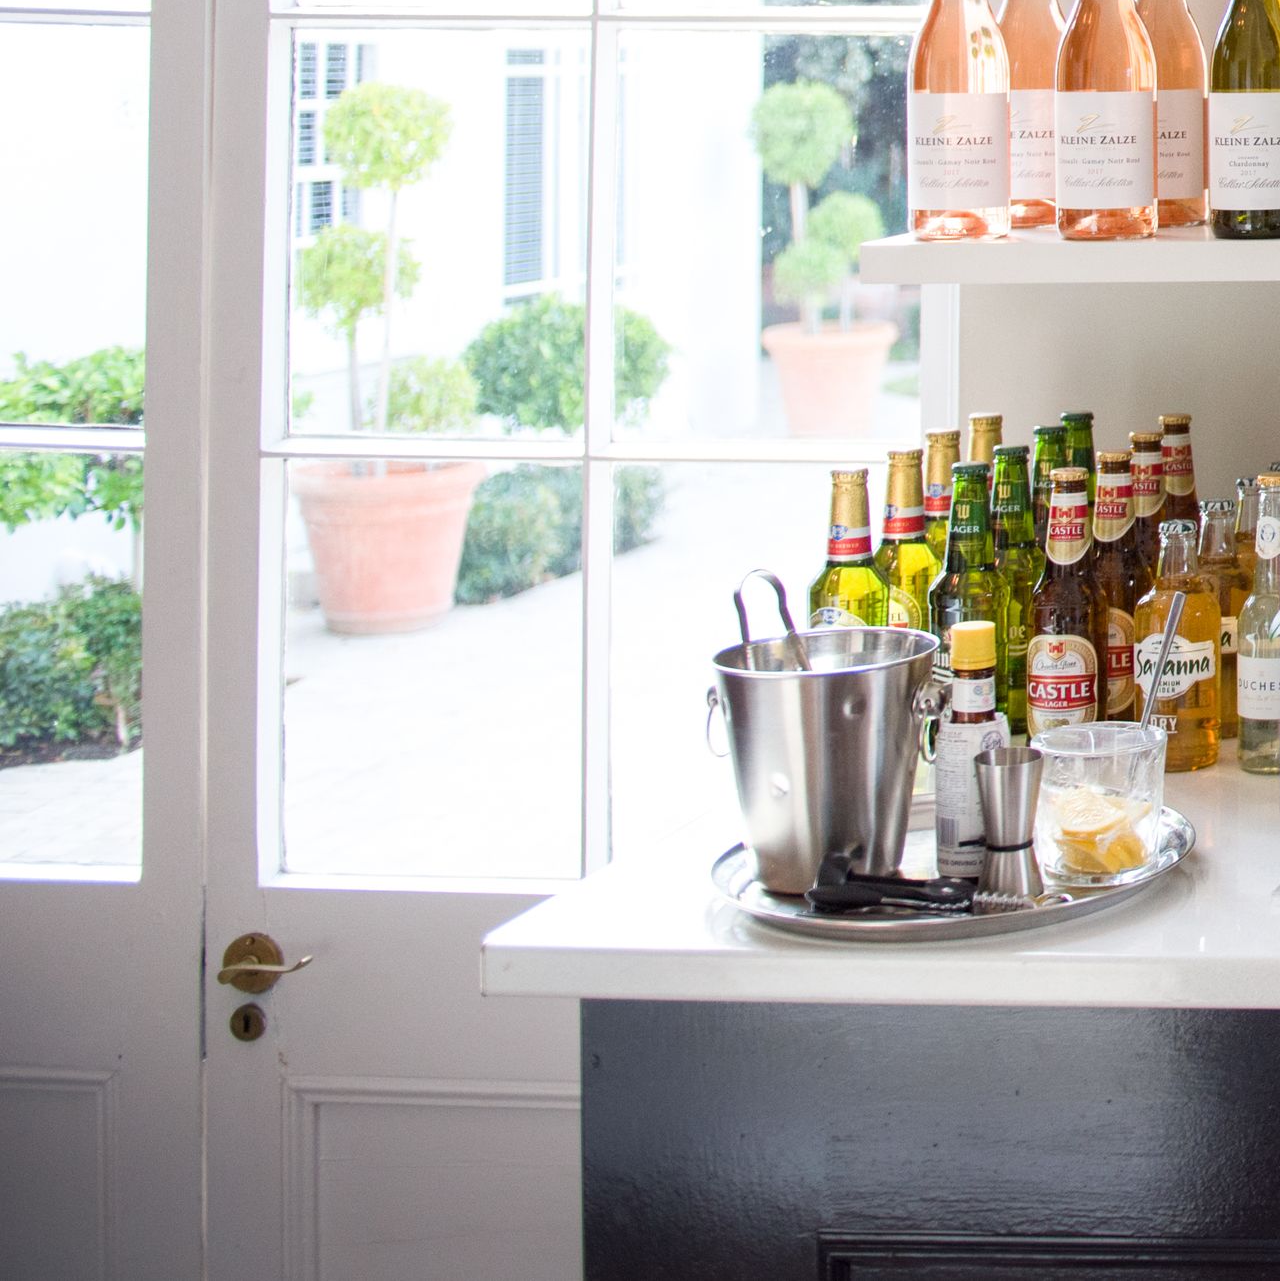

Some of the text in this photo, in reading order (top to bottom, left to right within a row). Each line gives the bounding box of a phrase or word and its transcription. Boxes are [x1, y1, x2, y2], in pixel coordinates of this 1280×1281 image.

[1019, 130, 1055, 138] ZALZE
[915, 136, 993, 146] KLEINE ZALZE
[1060, 135, 1137, 145] KLEINE ZALZE
[1215, 136, 1250, 146] KLEINE
[1228, 160, 1269, 168] Chardonnay
[1034, 480, 1052, 488] LAG
[1050, 525, 1083, 535] CASTLE
[1028, 681, 1091, 699] CASTLE
[1150, 717, 1178, 731] DRY
